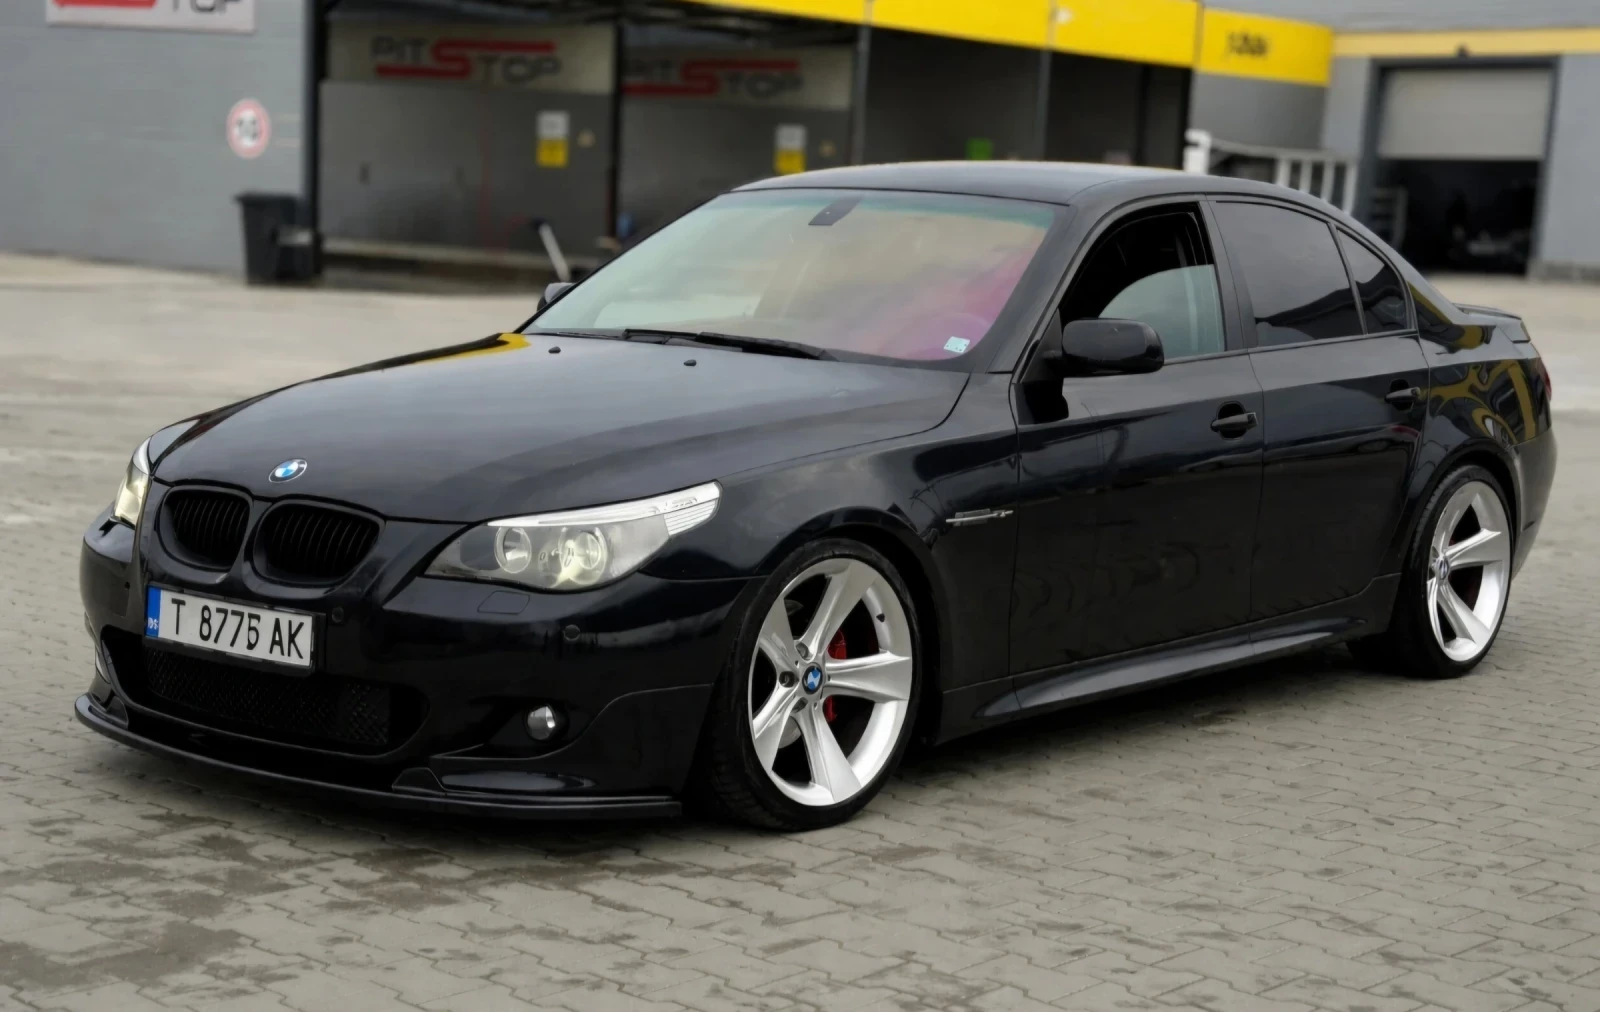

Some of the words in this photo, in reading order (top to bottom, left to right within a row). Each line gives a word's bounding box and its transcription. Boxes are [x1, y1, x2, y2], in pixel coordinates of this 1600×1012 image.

[371, 36, 427, 63] PIT
[171, 598, 186, 635] T
[269, 617, 305, 660] AK
